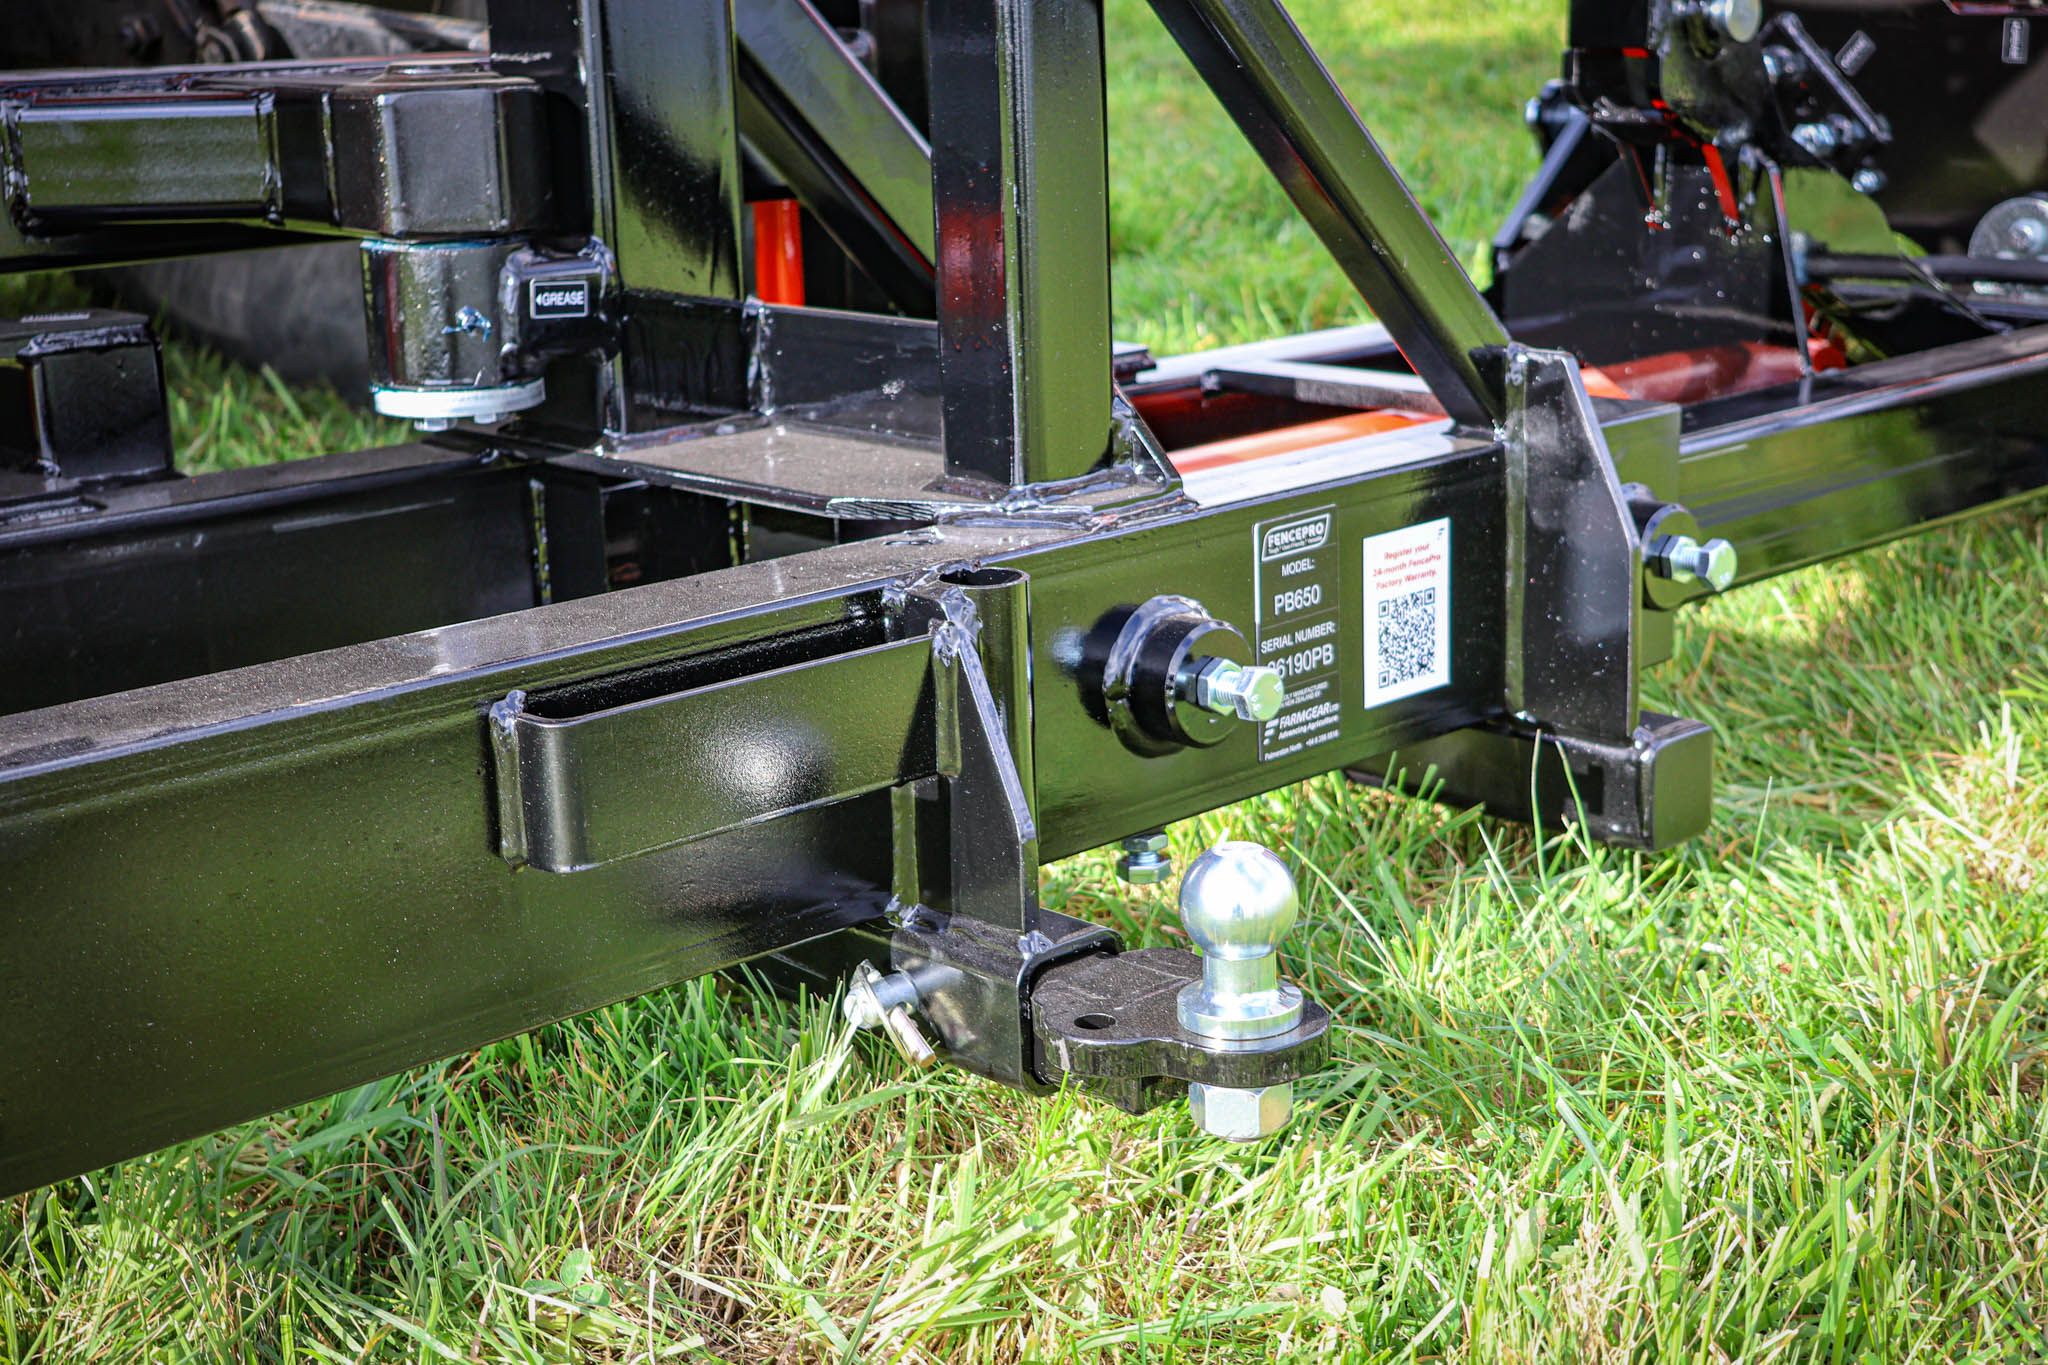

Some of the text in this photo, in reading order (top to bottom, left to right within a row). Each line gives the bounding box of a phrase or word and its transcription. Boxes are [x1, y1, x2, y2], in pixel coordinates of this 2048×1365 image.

[542, 290, 584, 306] GREASE
[1267, 522, 1325, 549] FENCEPRO
[1384, 543, 1430, 560] Register your
[1281, 557, 1316, 577] MODEL:
[1376, 578, 1402, 589] Factory
[1274, 583, 1321, 616] PB650
[1260, 620, 1337, 654] SERIAL NUMBER:
[1279, 701, 1331, 730] FARMGEAR
[1278, 725, 1308, 741] Advancing
